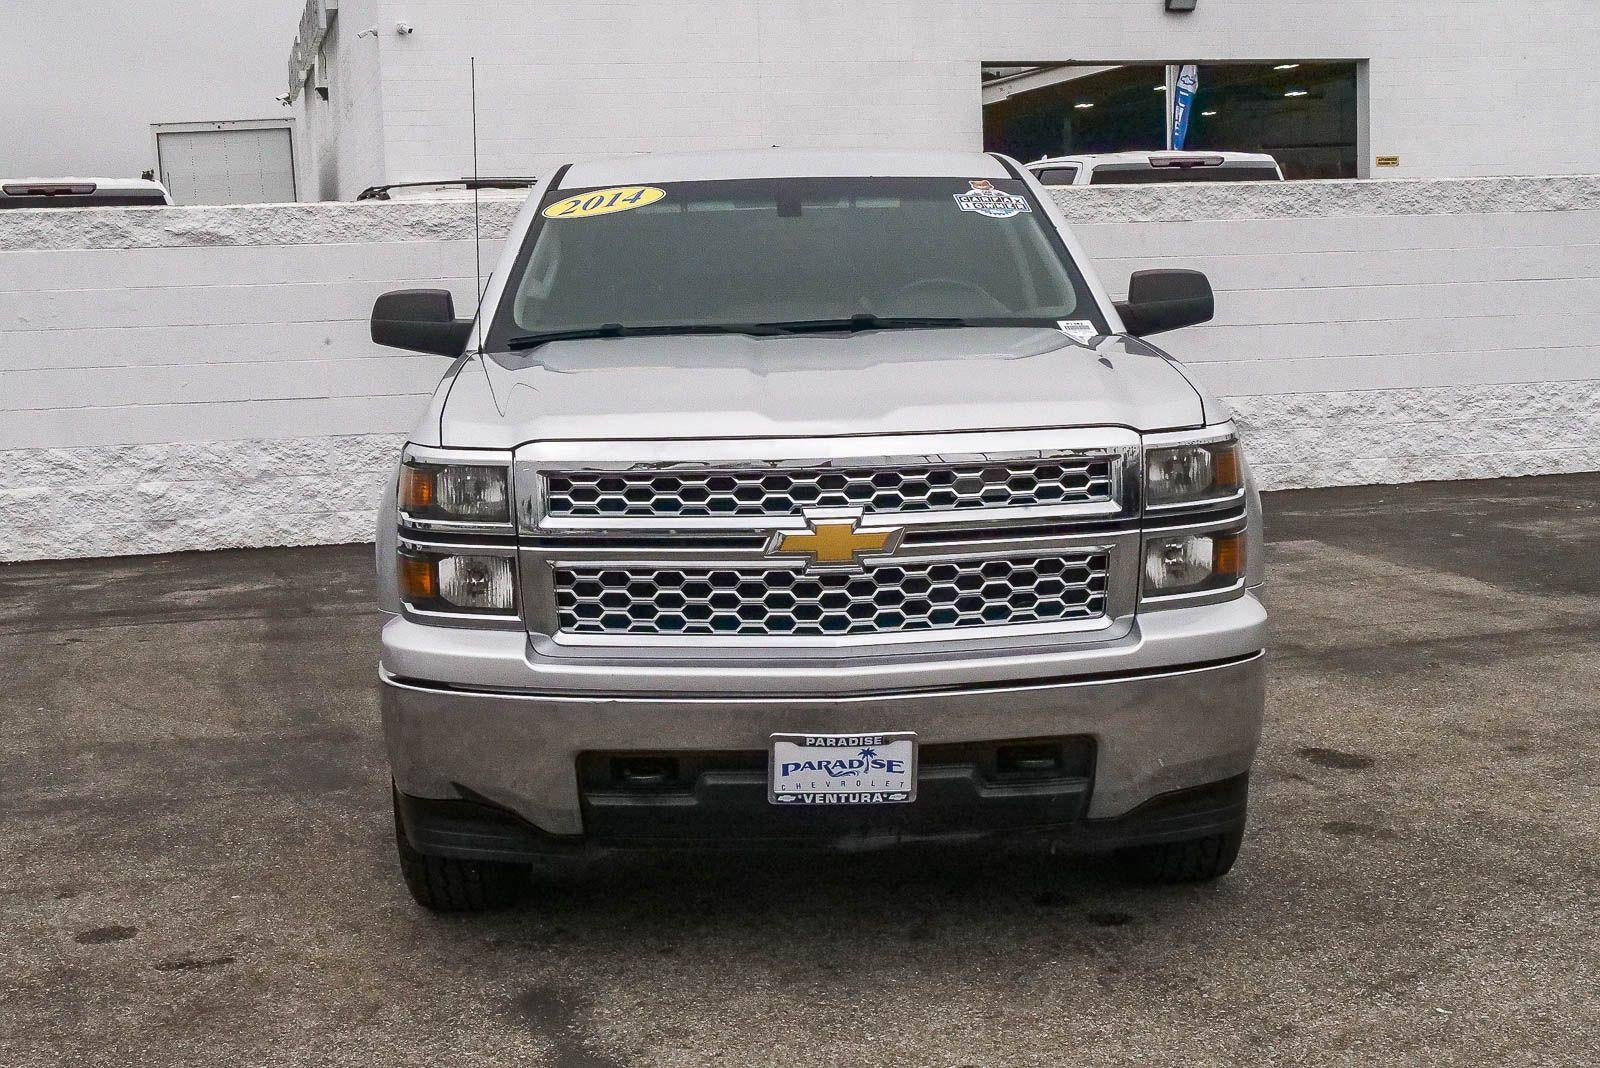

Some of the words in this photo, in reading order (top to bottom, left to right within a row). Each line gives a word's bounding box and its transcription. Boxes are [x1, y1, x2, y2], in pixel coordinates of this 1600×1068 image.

[559, 189, 646, 216] 2014
[806, 736, 883, 747] PARADISE
[781, 748, 905, 777] PARADISE
[781, 780, 904, 791] CHEVROLET
[802, 793, 883, 804] VENTURA
